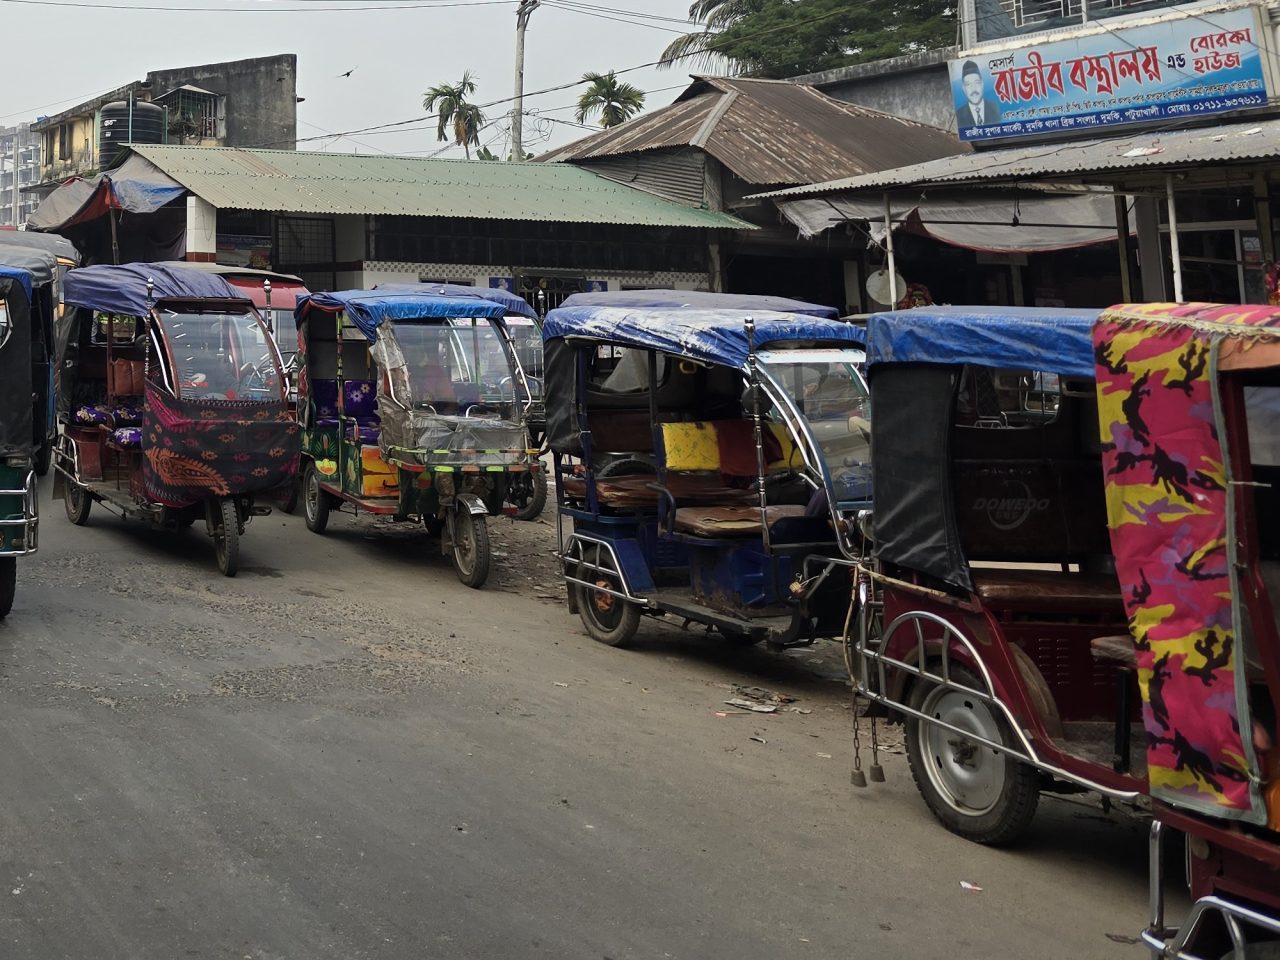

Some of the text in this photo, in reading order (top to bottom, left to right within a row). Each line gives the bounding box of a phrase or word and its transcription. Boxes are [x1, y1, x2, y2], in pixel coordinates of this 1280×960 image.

[988, 52, 1015, 69] মেসার্স
[991, 27, 1252, 104] রাজীব বস্ত্রালয় এন্ড বোরকা
[1192, 51, 1241, 74] হাউজ
[965, 126, 983, 137] রাজীব
[985, 126, 1000, 136] সুপার
[1025, 119, 1044, 132] দুমকি
[1045, 119, 1059, 128] থানা
[1061, 116, 1074, 127] ব্রিজ
[1100, 110, 1123, 123] দুমকি,
[1125, 105, 1159, 119] পটুয়াখালী
[1167, 103, 1190, 114] মোবাঃ
[1193, 95, 1261, 111] ০১৭১১-৯৩৭৬১১
